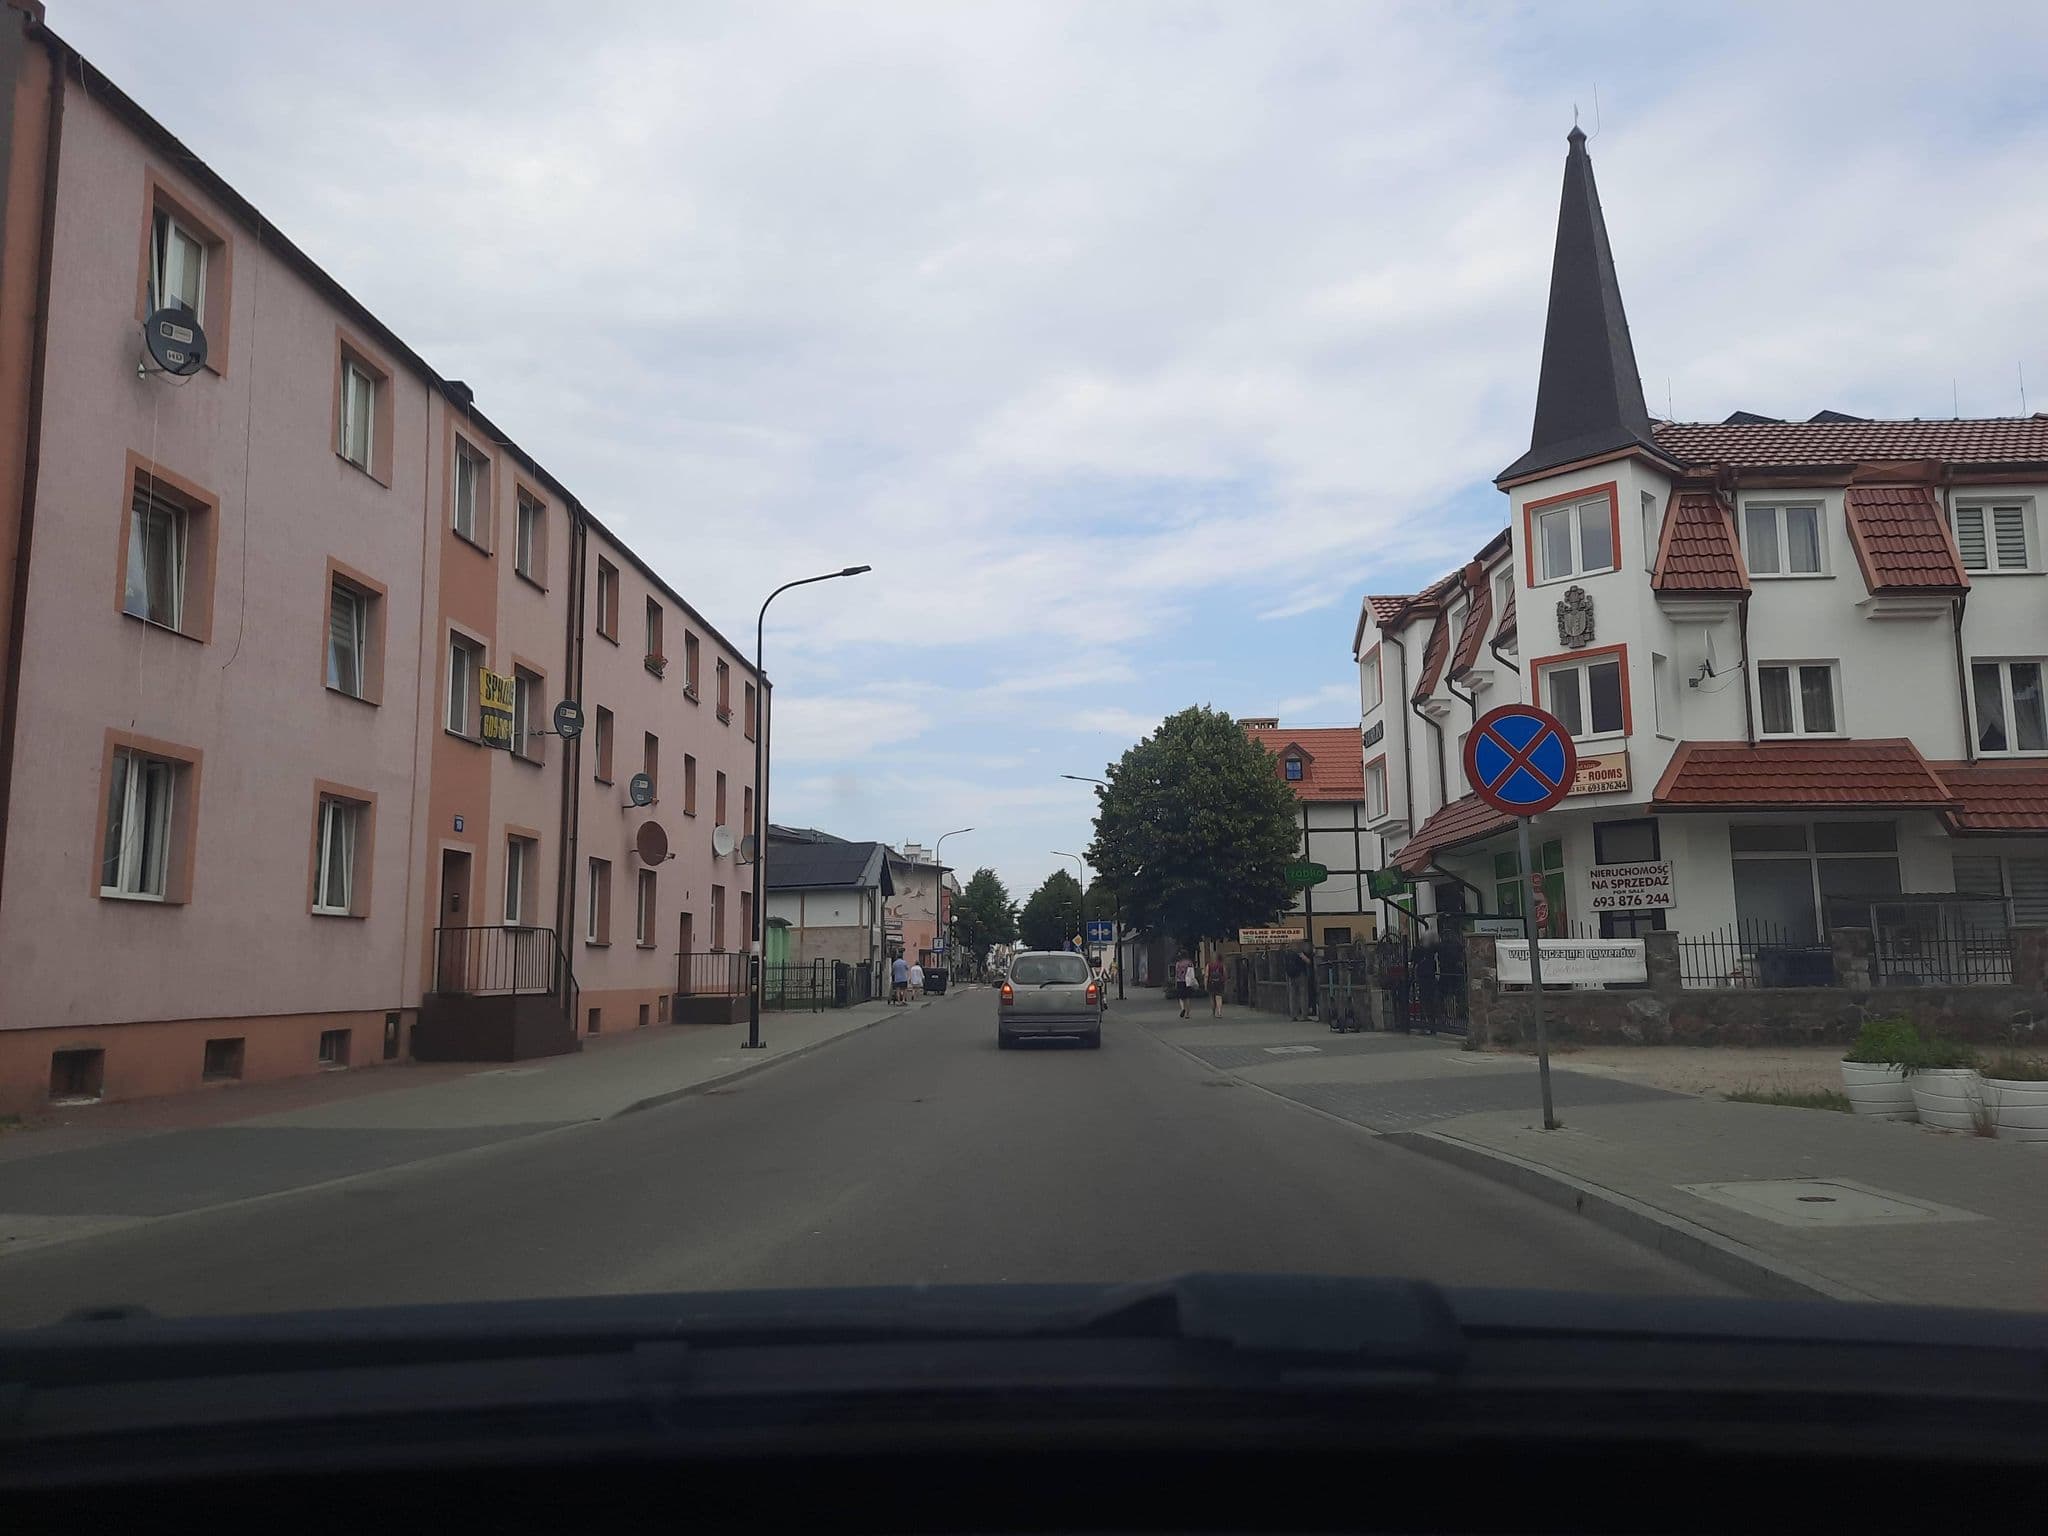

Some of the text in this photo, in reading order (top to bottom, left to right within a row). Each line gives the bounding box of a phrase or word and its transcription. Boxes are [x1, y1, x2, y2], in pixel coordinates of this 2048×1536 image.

[1588, 768, 1623, 781] ROOMS
[1591, 874, 1669, 890] NA SPRZEDAŻ
[1593, 893, 1669, 908] 693 876 244
